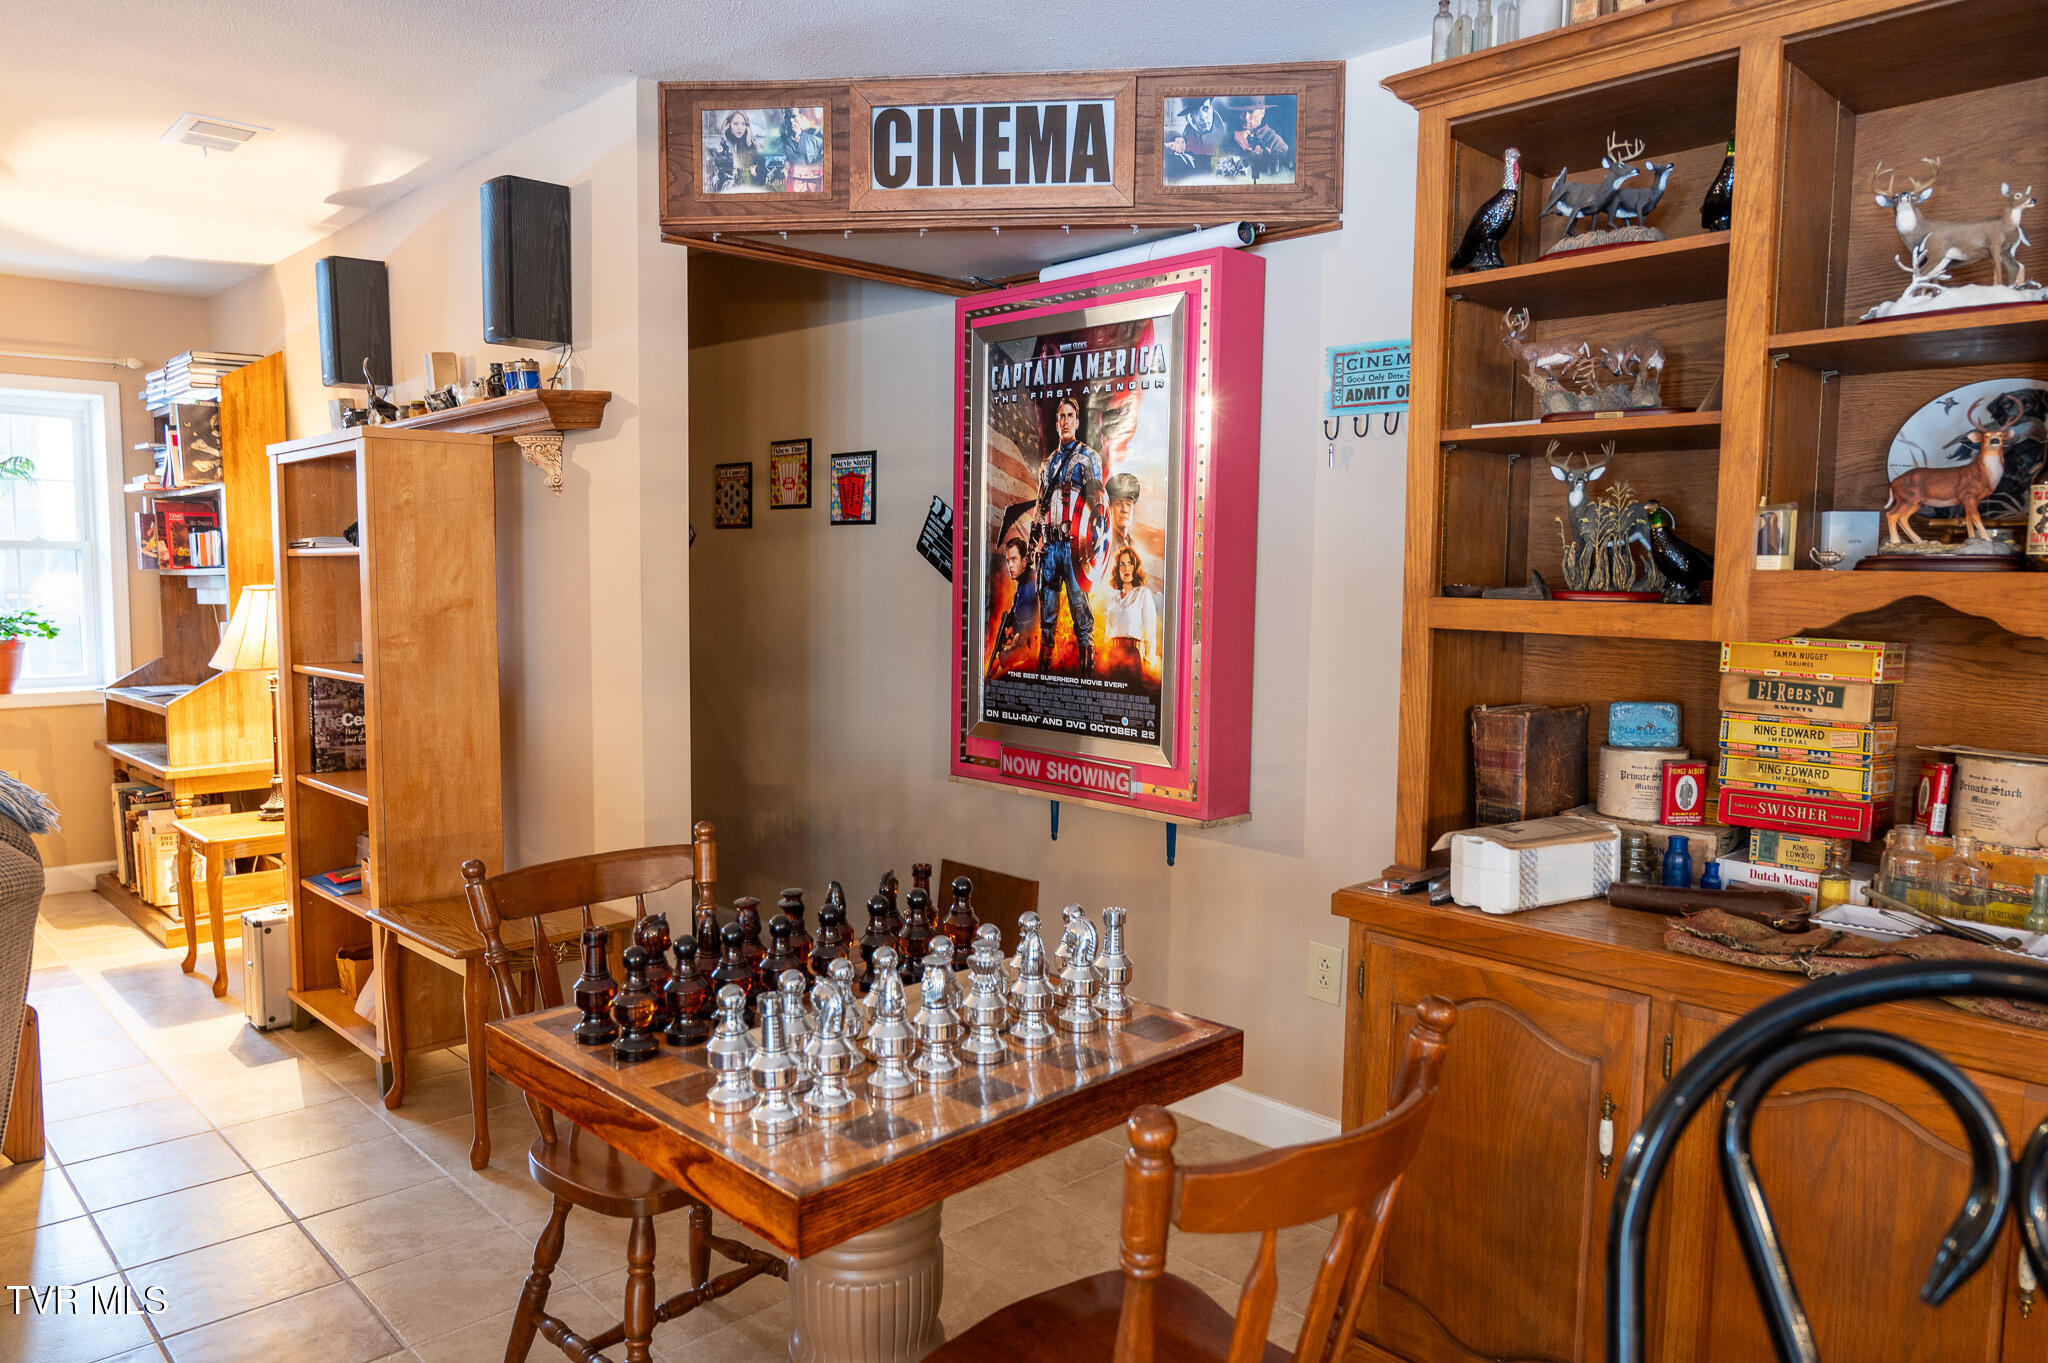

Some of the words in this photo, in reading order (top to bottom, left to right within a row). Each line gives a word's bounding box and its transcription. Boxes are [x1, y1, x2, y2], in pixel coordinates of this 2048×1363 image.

[874, 104, 1111, 189] CINEMA
[992, 357, 1064, 391] CAPTAIN
[1072, 344, 1166, 382] AMERICA
[1347, 375, 1366, 384] Good
[1368, 372, 1385, 384] Only
[1387, 372, 1404, 381] Date
[994, 394, 1018, 405] THE
[1030, 387, 1073, 400] FIRST
[1082, 379, 1165, 395] AVENGER
[1345, 386, 1391, 402] ADMIT
[1773, 650, 1797, 659] TAMPA
[1799, 652, 1829, 662] NUGGET
[1785, 660, 1814, 668] SUBLIMES
[1040, 675, 1079, 685] SUPERHERO
[1081, 678, 1102, 687] MOVIE
[1757, 680, 1834, 706] El-Rees-So
[1774, 704, 1813, 713] SWEETS
[315, 712, 343, 730] The
[986, 709, 1000, 719] ON
[1042, 717, 1063, 727] AND
[1066, 720, 1087, 730] DVD
[1090, 723, 1138, 738] OCTOBER
[1753, 725, 1777, 736] KING
[1781, 728, 1825, 741] EDWARD
[1768, 737, 1808, 746] IMPERIAL
[1003, 754, 1041, 777] NOW
[1046, 761, 1130, 792] SHOWING
[1620, 769, 1650, 781] Private
[1757, 762, 1782, 774] KING
[1785, 766, 1829, 780] EDWARD
[1772, 775, 1812, 785] IMPERIAL
[1960, 780, 1989, 794] Private
[1757, 801, 1829, 822] SWISHER
[1785, 850, 1816, 861] EDWARD
[1792, 844, 1809, 852] KING
[1749, 868, 1780, 883] Dutch
